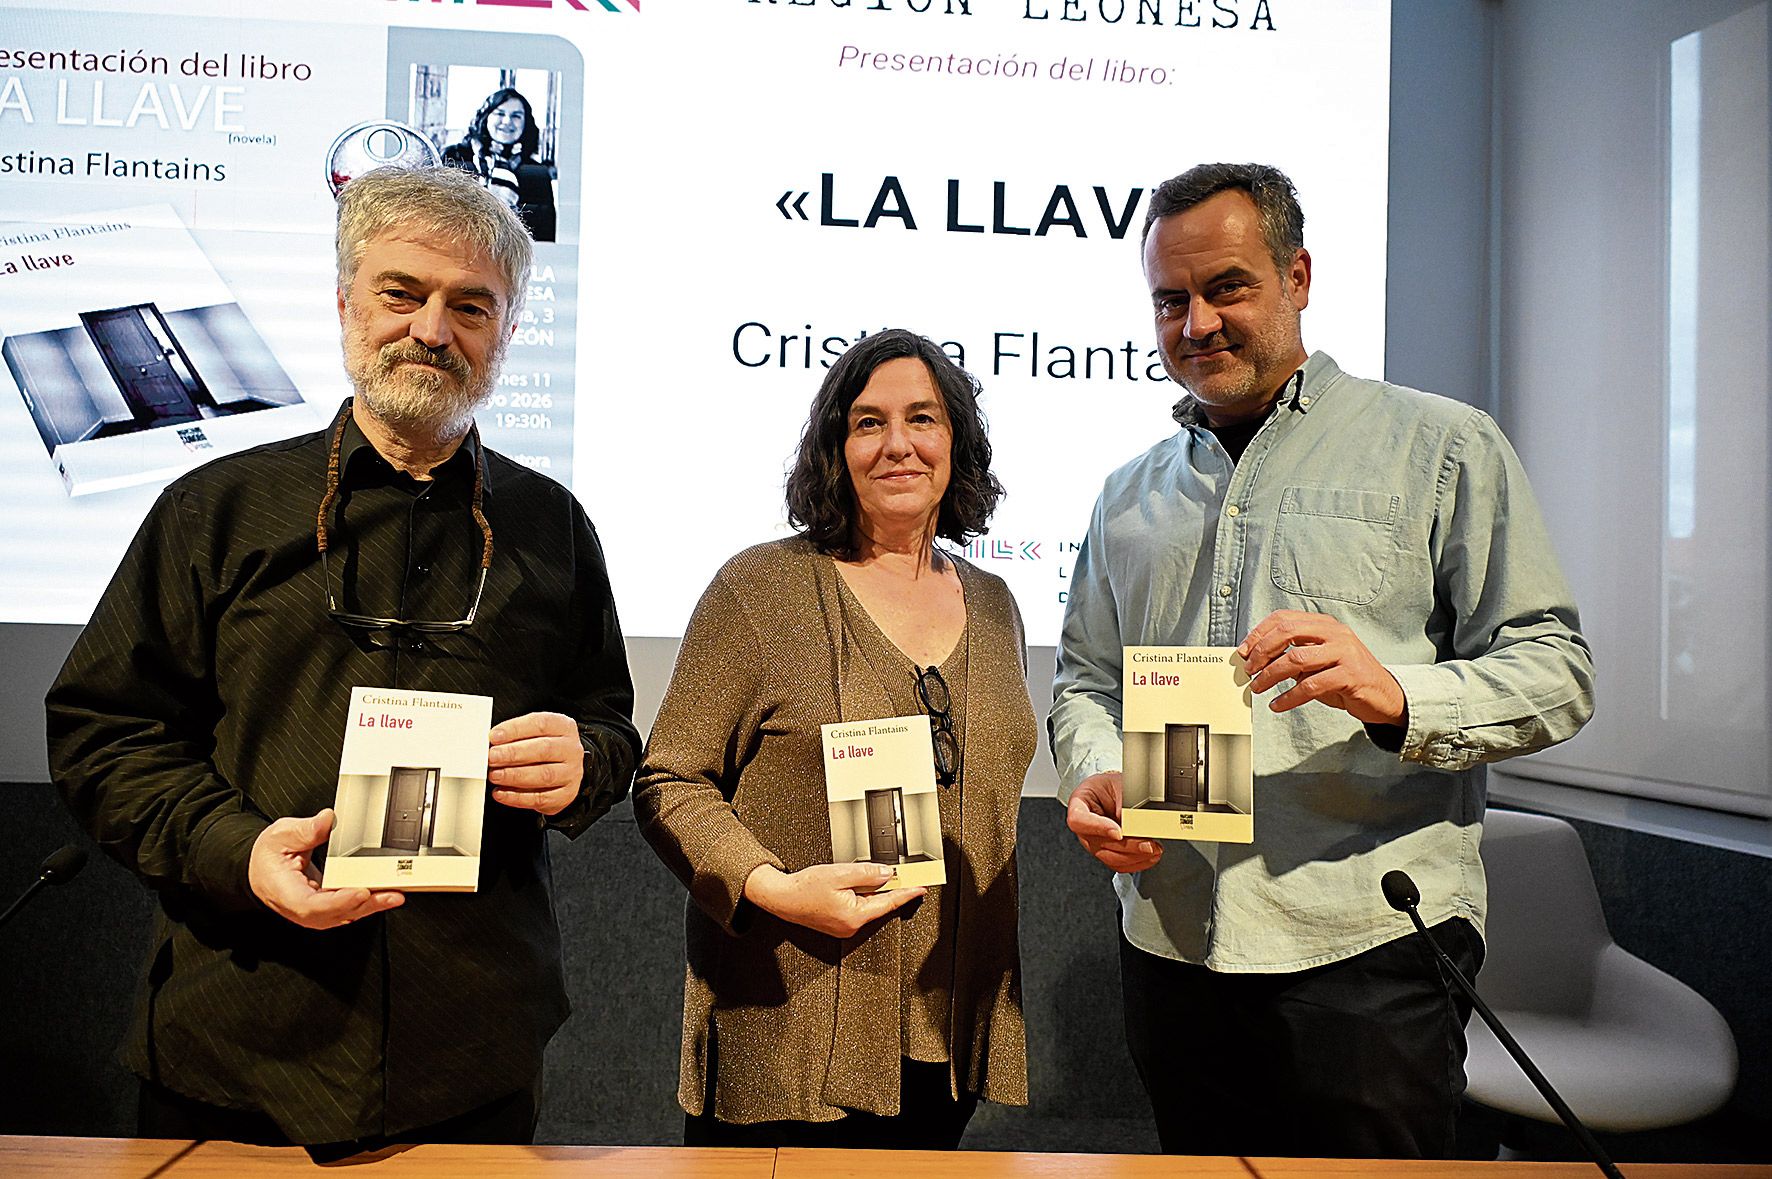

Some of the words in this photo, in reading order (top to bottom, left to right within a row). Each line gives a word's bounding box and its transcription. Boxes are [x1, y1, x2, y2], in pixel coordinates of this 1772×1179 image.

[180, 52, 228, 78] del
[241, 54, 312, 81] libro
[838, 45, 1037, 78] Presentación
[1049, 57, 1094, 81] del
[1103, 59, 1176, 85] libro:
[0, 76, 35, 124] A
[57, 79, 247, 132] LLAVE
[0, 150, 74, 175] stina
[86, 152, 226, 182] Flantains
[776, 172, 918, 230] «LA
[947, 178, 1156, 240] LLAV
[53, 222, 131, 239] Flantains
[21, 254, 75, 272] llave
[542, 307, 555, 324] 3
[510, 326, 554, 347] EÓN
[533, 372, 551, 388] 11
[510, 392, 553, 409] 2026
[496, 413, 552, 430] 19:30h
[1132, 653, 1174, 663] Cristina
[1176, 653, 1224, 664] Flantains
[1132, 671, 1147, 686] La
[1150, 671, 1180, 686] llave
[362, 694, 408, 706] Cristina
[412, 697, 463, 710] Flantains
[359, 713, 375, 728] La
[380, 714, 413, 729] llave
[830, 728, 866, 739] Cristina
[868, 725, 909, 736] Flantains
[831, 747, 845, 760] La
[847, 745, 874, 758] llave
